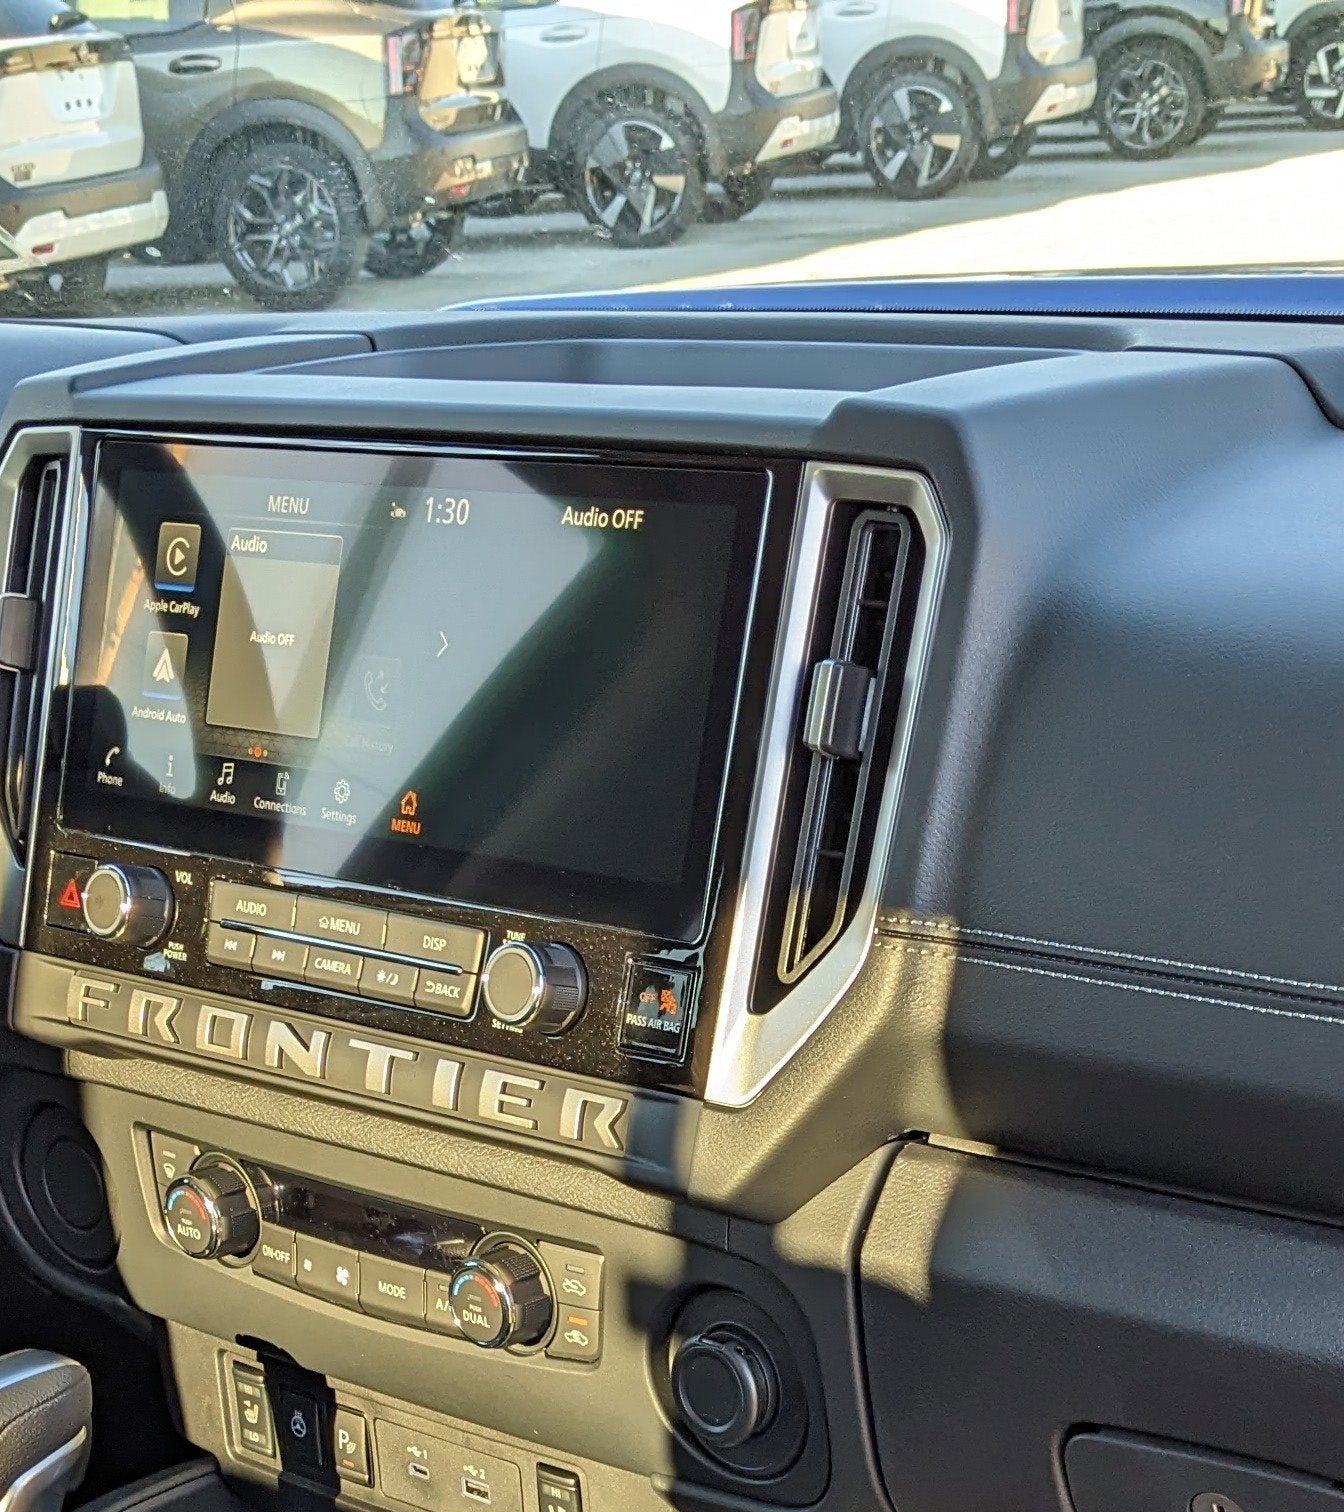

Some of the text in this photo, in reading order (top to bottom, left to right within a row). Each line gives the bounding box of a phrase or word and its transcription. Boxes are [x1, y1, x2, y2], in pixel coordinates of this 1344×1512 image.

[267, 495, 310, 515] MENU
[425, 496, 470, 526] 1:30
[561, 505, 645, 530] Audio OFF
[230, 534, 268, 553] Audio
[143, 598, 201, 618] Apple CarPlay
[249, 630, 296, 647] Audio OFF
[131, 705, 187, 725] Android Auto
[97, 770, 123, 788] Phone
[158, 782, 176, 796] Info
[209, 789, 236, 806] Audio
[253, 796, 307, 817] Connections
[320, 806, 357, 827] Settings
[391, 817, 421, 836] MENU
[175, 870, 193, 886] VOL
[235, 898, 267, 918] AUDIO
[329, 917, 361, 936] MENU
[168, 941, 185, 952] PUSH
[422, 935, 447, 952] DISP
[163, 948, 188, 962] POWER
[314, 956, 352, 976] CAMERA
[435, 982, 461, 1000] BACK
[639, 991, 658, 1004] OFF
[625, 1012, 681, 1034] PASS AIR BAG
[67, 974, 632, 1150] FRONTIER
[177, 1223, 202, 1241] AUTO
[378, 1280, 407, 1300] MODE
[435, 1298, 451, 1313] A/
[462, 1309, 491, 1329] DUAL
[479, 1469, 486, 1480] 2
[551, 1486, 561, 1499] HI
